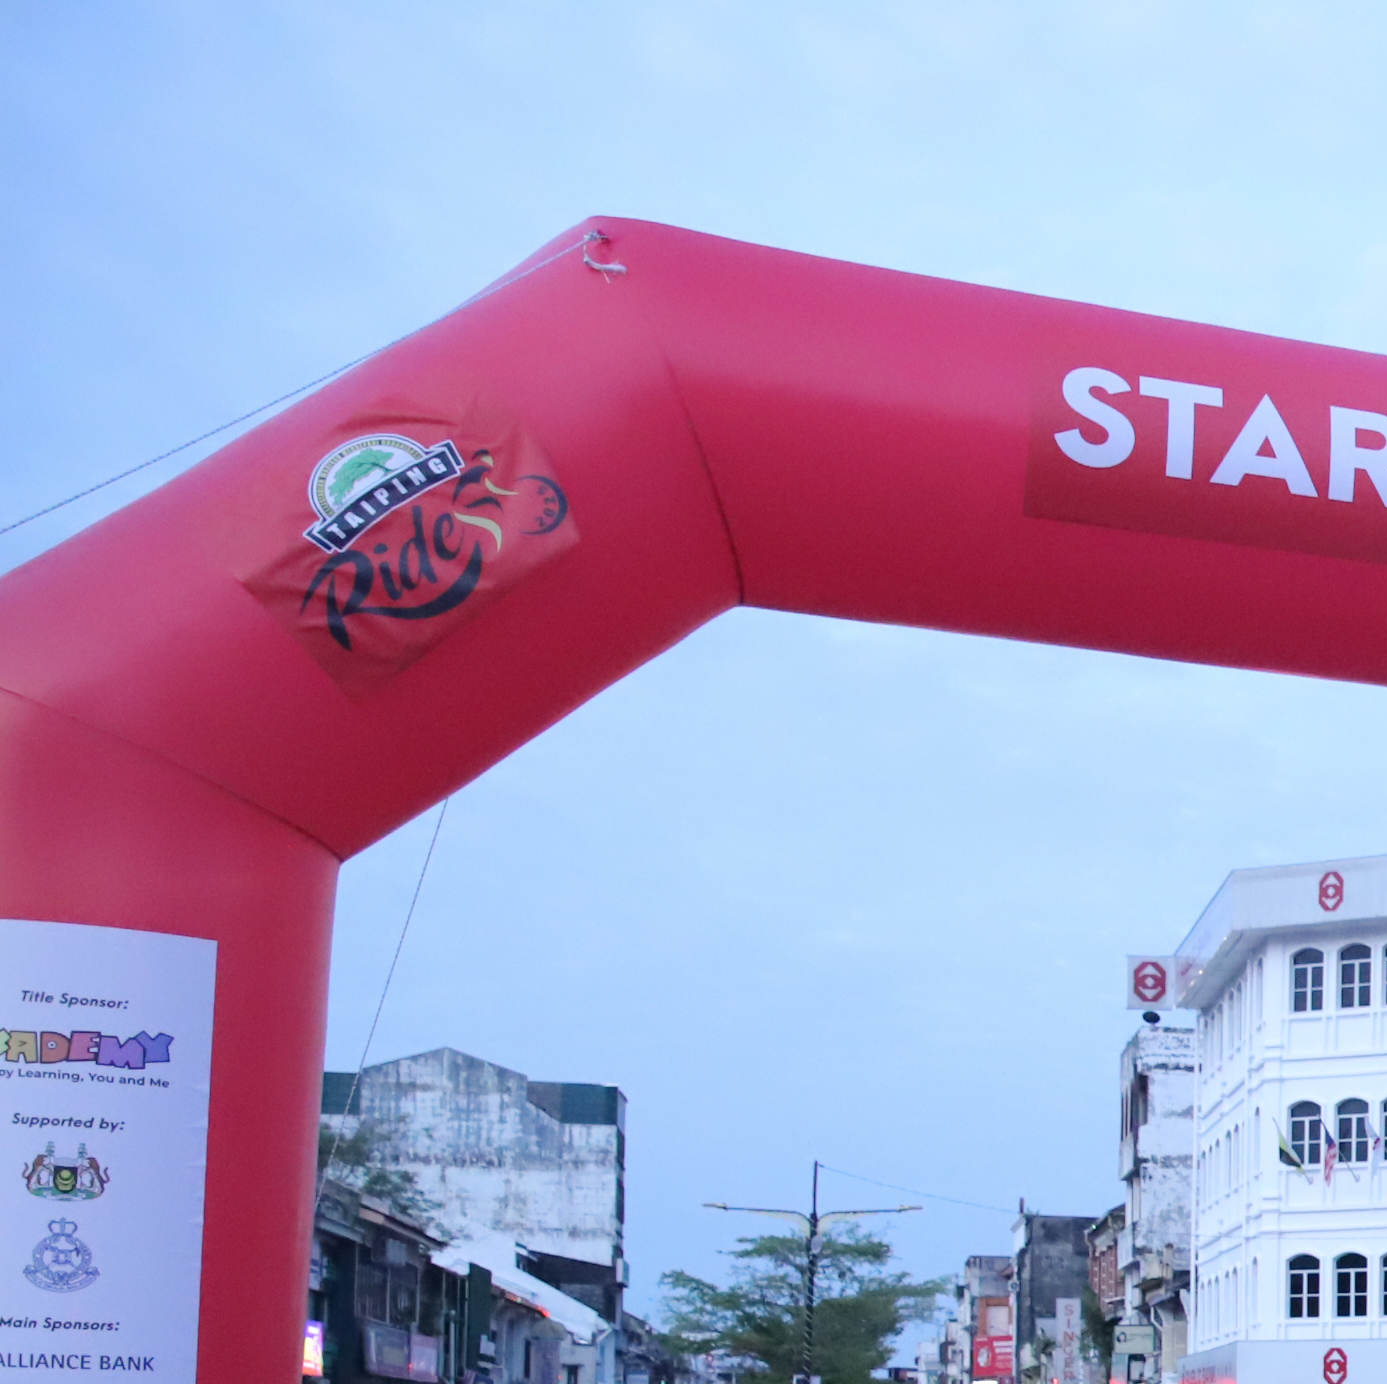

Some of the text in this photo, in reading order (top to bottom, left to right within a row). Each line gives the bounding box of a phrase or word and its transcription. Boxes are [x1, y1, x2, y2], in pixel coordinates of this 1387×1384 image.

[326, 457, 448, 540] TAIPING
[299, 505, 482, 652] Ride
[21, 990, 129, 1010] Title Sponsor:
[0, 1028, 175, 1070] ADEMY
[18, 1068, 84, 1083] Learning,
[89, 1073, 115, 1084] You
[119, 1076, 145, 1087] and
[150, 1078, 170, 1088] Me
[12, 1112, 125, 1132] Supported by:
[0, 1316, 120, 1332] Main Sponsors:
[1063, 1304, 1076, 1382] SINGER
[100, 1355, 155, 1371] BANK
